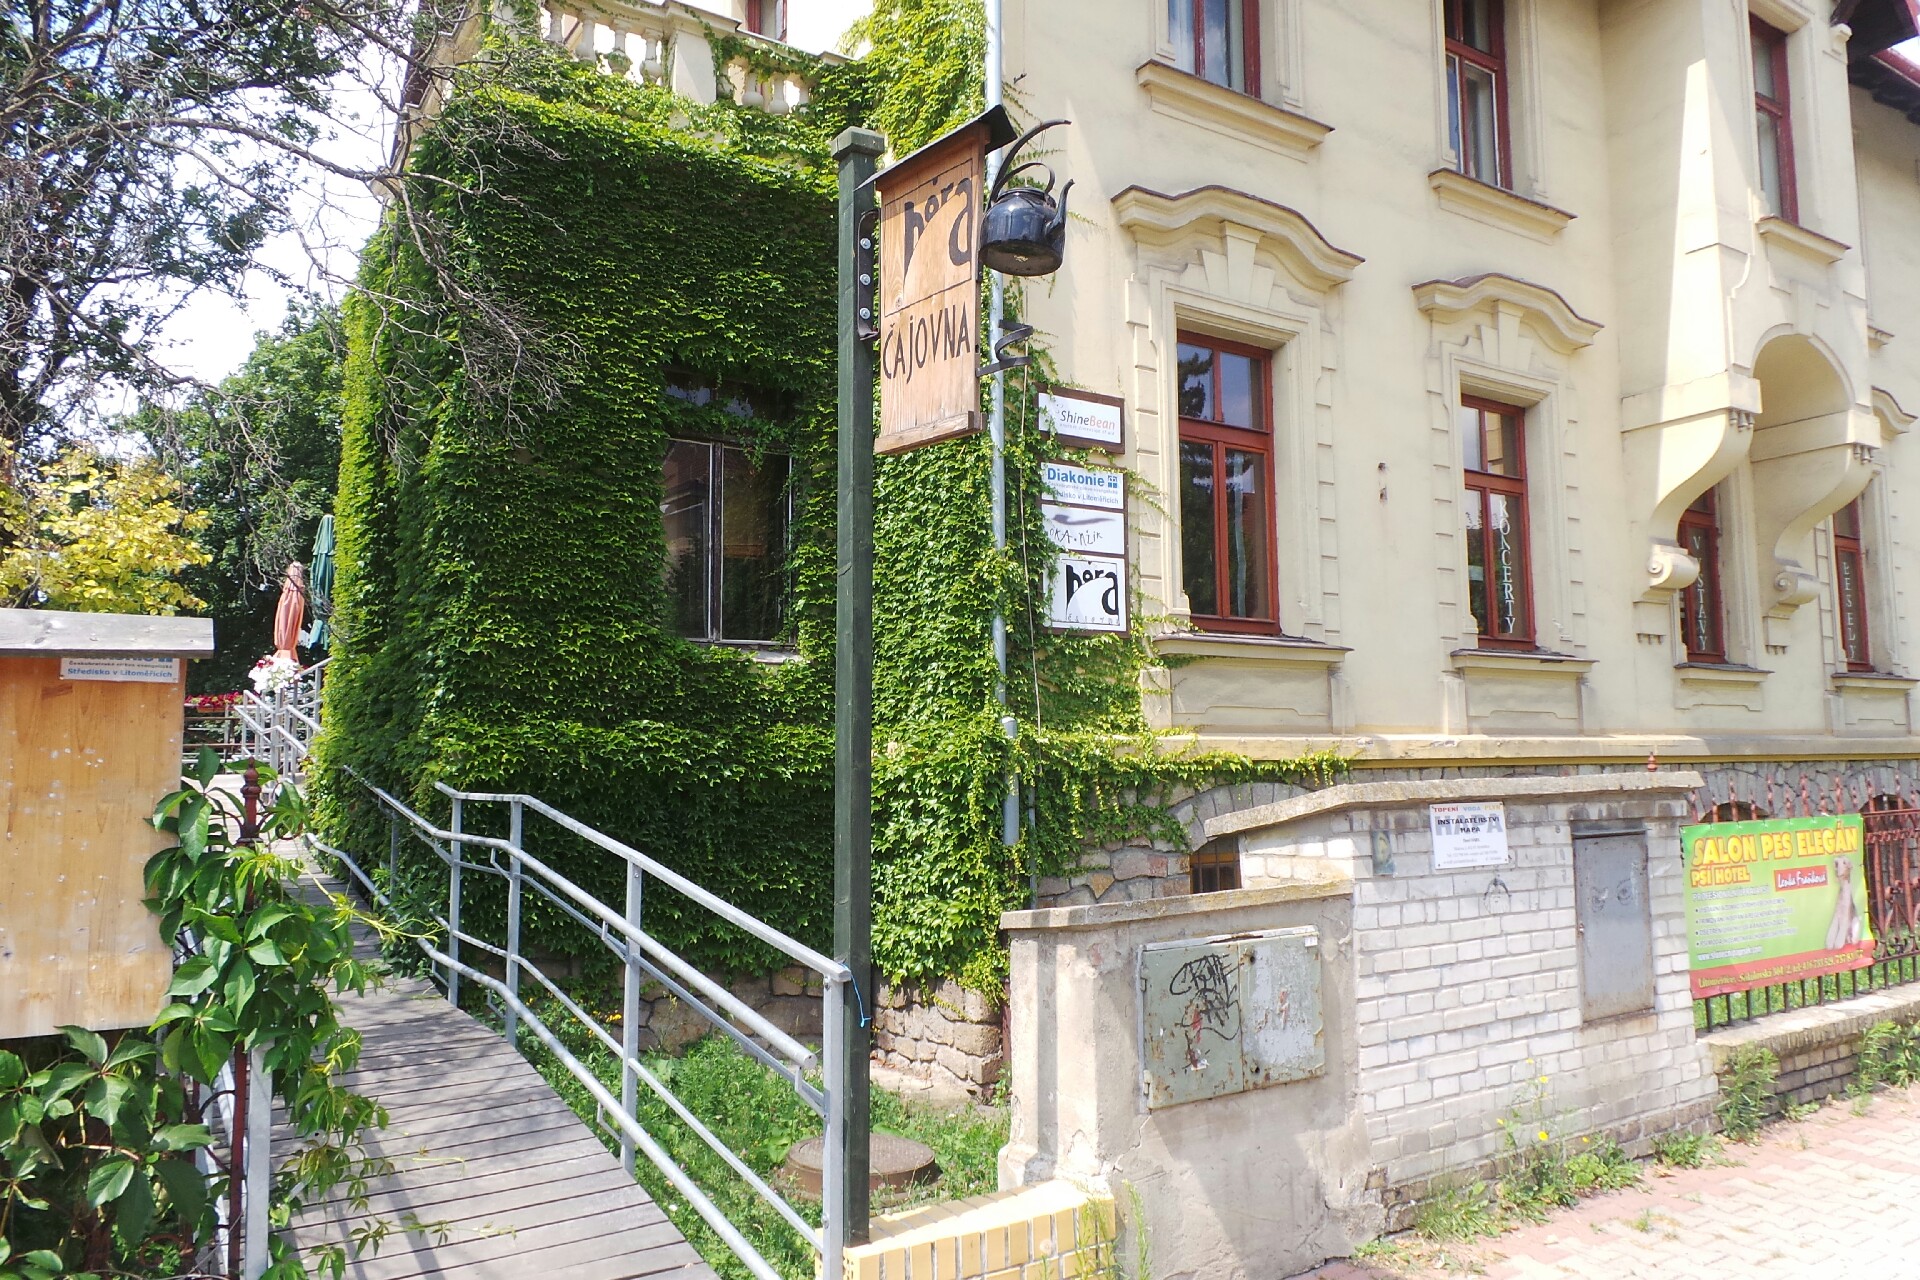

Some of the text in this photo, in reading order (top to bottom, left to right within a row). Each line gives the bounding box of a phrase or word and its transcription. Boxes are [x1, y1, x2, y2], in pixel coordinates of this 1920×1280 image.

[882, 300, 971, 385] ČAJOVNA
[1060, 410, 1115, 431] ShineBean
[1047, 467, 1105, 487] Diakonie
[1499, 500, 1516, 634] KONCERTY
[67, 668, 110, 676] Středisko
[120, 669, 173, 678] Litoměřicích
[1694, 822, 1857, 866] SALON PES ELEGÁN
[1691, 865, 1750, 887] PSÍ HOTEL
